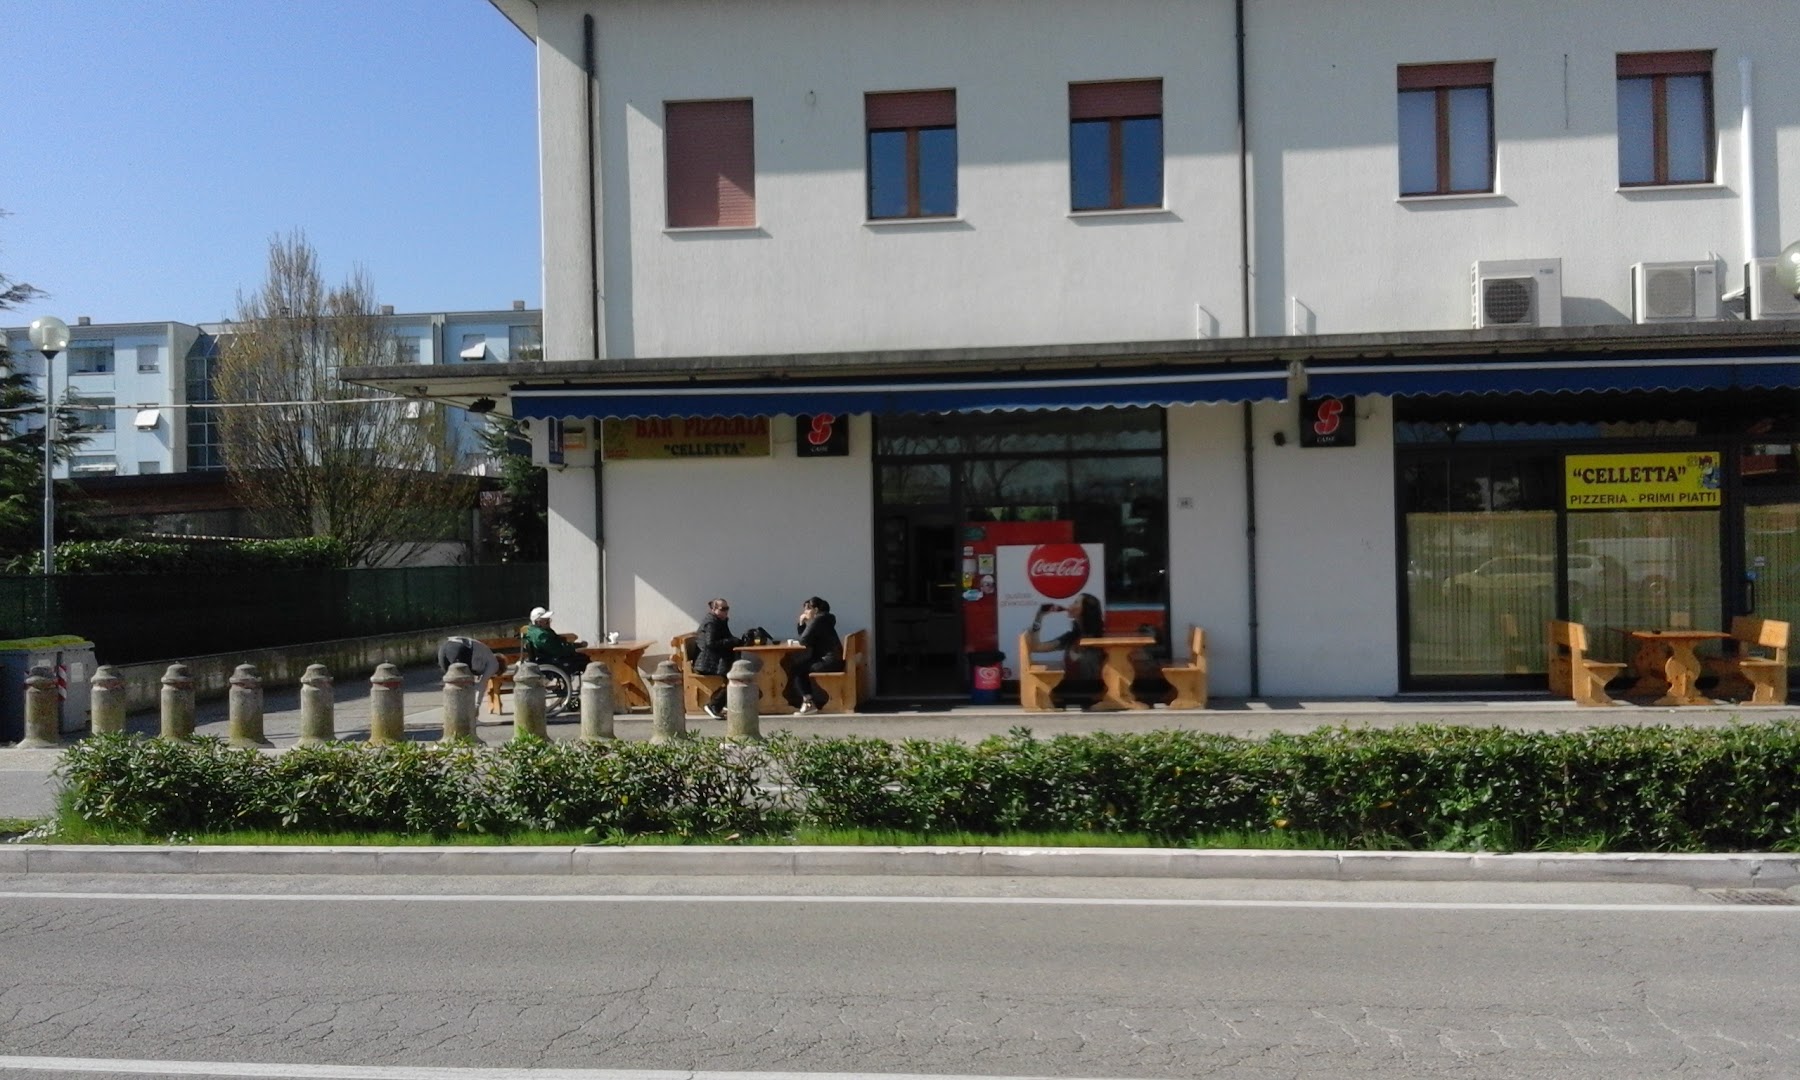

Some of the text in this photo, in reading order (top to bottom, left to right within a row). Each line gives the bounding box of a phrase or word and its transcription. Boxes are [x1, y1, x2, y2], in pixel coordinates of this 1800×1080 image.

[637, 416, 768, 437] BAR PIZZERIA
[1570, 494, 1627, 505] PIZZERIA
[1638, 492, 1675, 504] PRIMI
[1679, 491, 1716, 503] PIATTI
